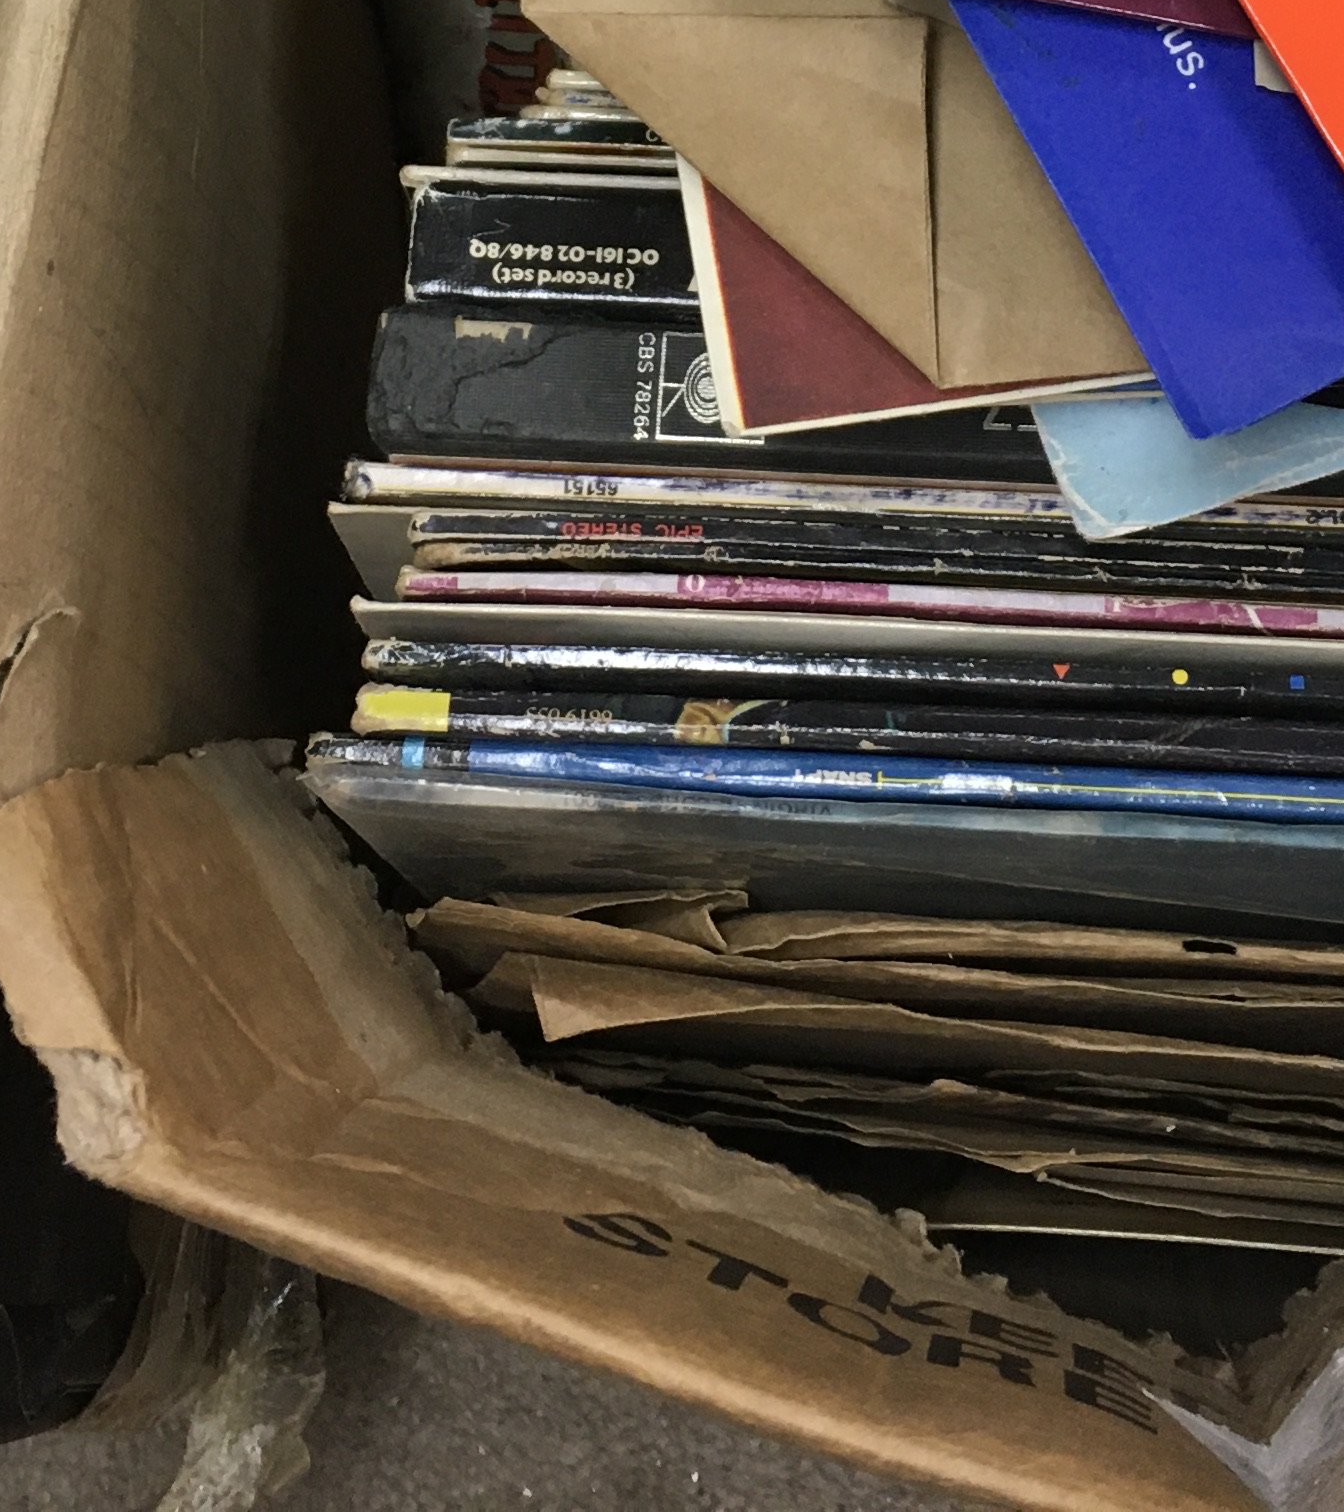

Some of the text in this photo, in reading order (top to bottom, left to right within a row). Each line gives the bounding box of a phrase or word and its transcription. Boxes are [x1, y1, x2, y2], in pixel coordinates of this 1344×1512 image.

[633, 332, 656, 441] CBS 78264
[562, 478, 619, 498] 65151
[561, 521, 704, 540] EPIC STEREO
[562, 1210, 1161, 1437] STORE
